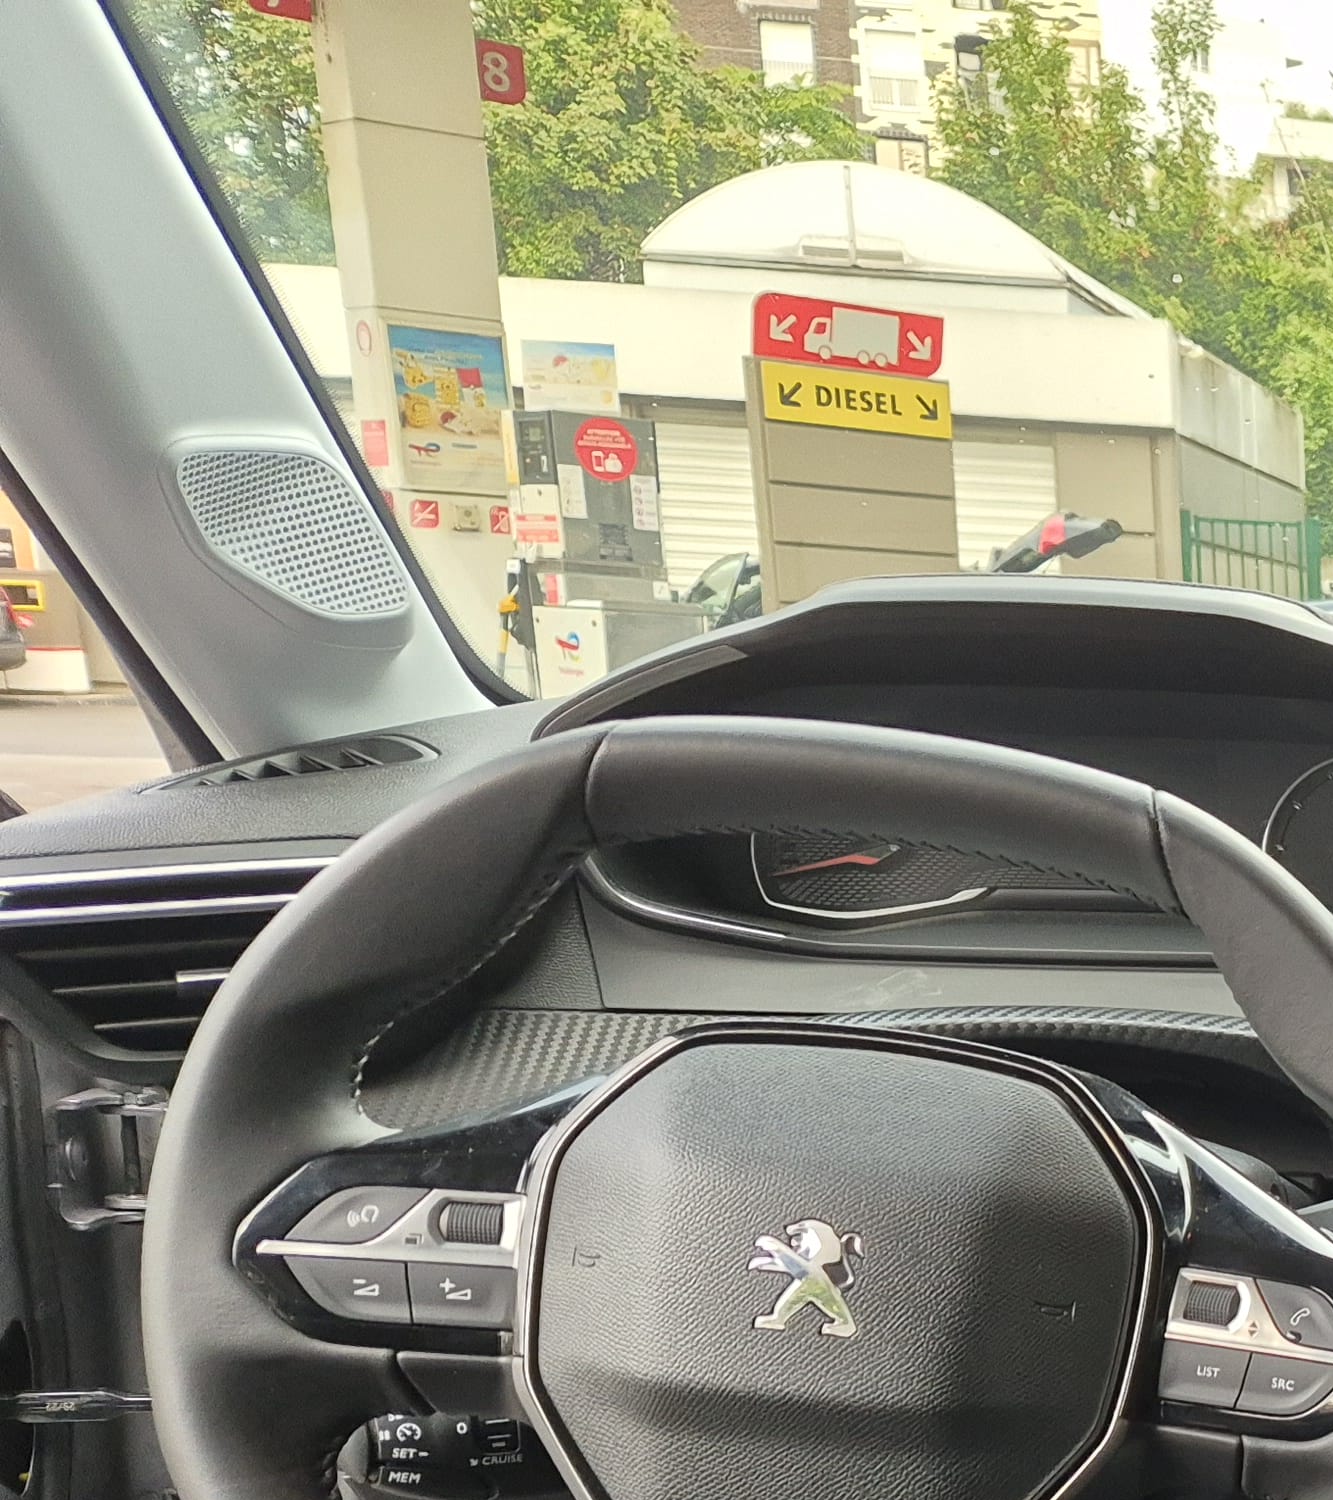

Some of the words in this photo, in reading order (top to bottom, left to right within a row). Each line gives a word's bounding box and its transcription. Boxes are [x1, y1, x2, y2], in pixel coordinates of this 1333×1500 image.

[482, 51, 511, 92] 8
[815, 384, 903, 416] DIESEL
[1196, 1365, 1220, 1378] LIST
[1271, 1377, 1295, 1391] SRC
[391, 1448, 418, 1459] SET
[481, 1454, 523, 1466] CRUISE
[387, 1471, 421, 1484] MEM
